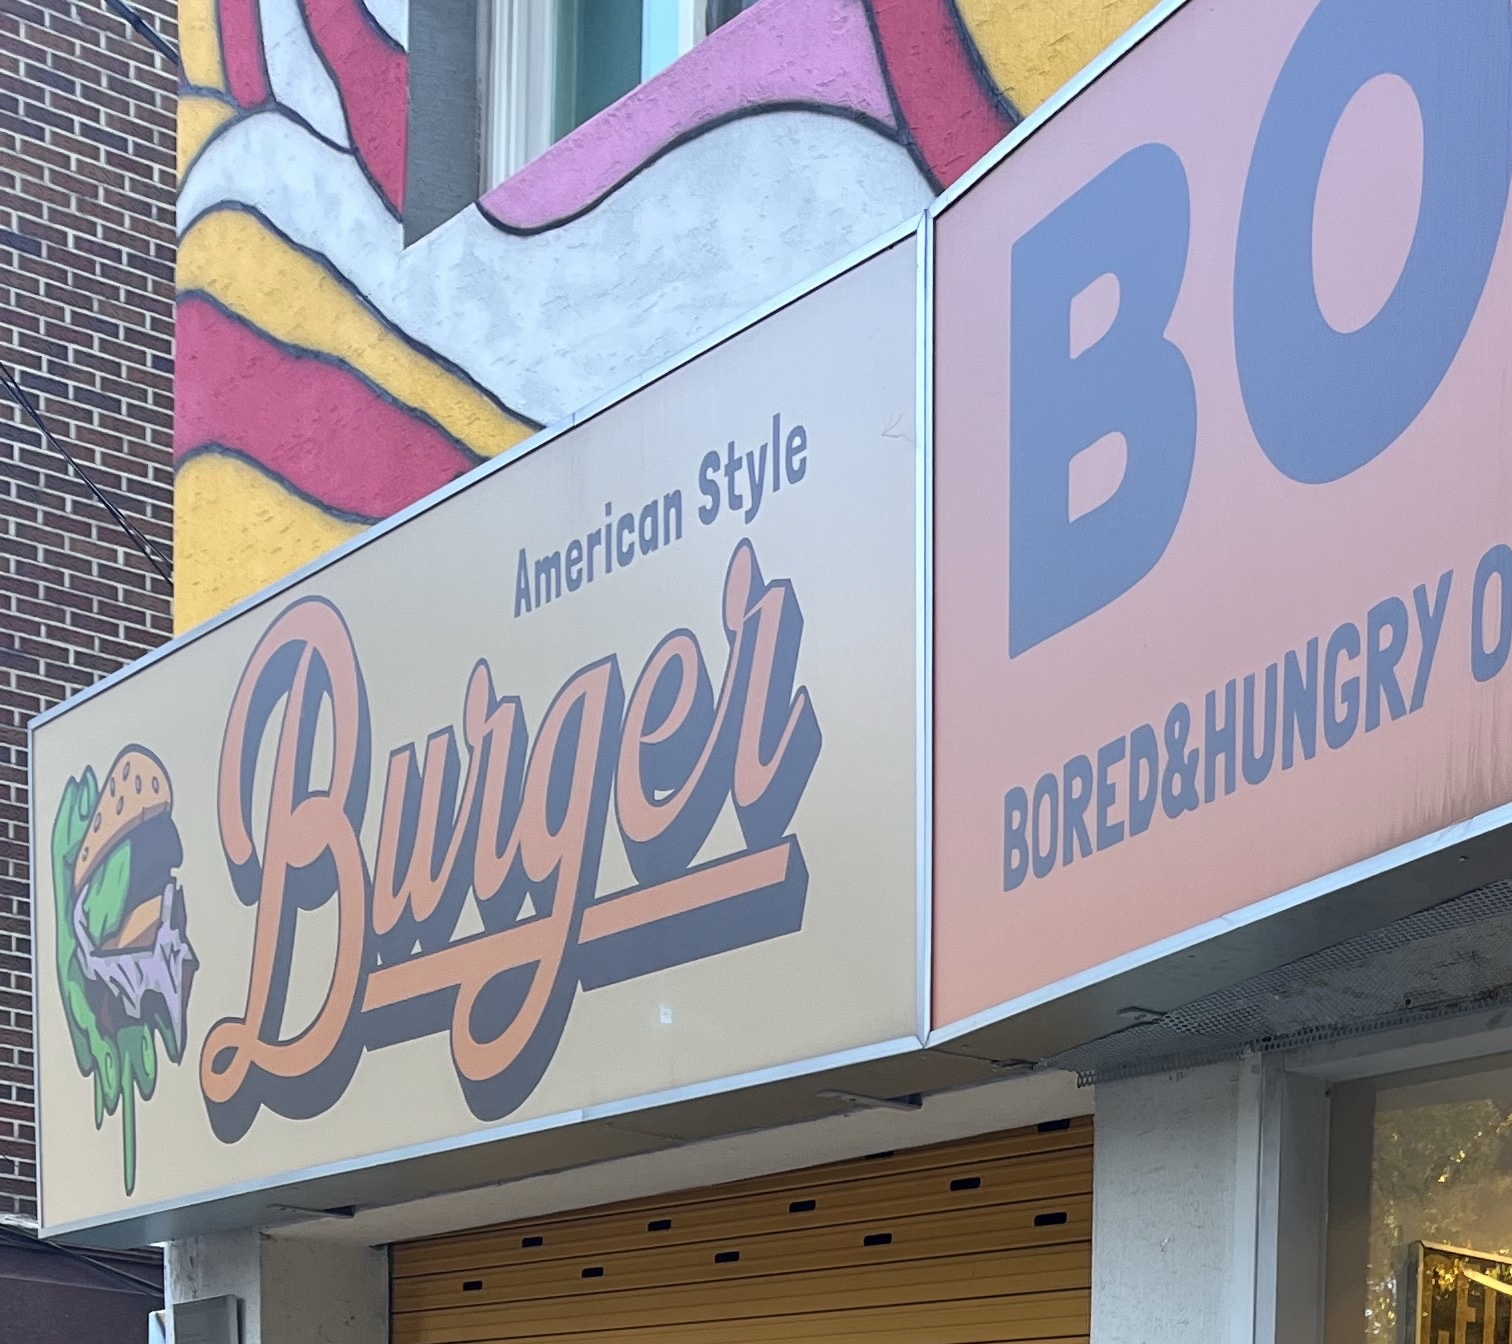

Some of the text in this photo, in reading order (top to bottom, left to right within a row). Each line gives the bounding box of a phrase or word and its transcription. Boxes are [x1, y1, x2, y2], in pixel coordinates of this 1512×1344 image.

[514, 412, 807, 619] American Style
[200, 538, 822, 1143] Burger
[1003, 569, 1454, 892] BORED&HUNGRY
